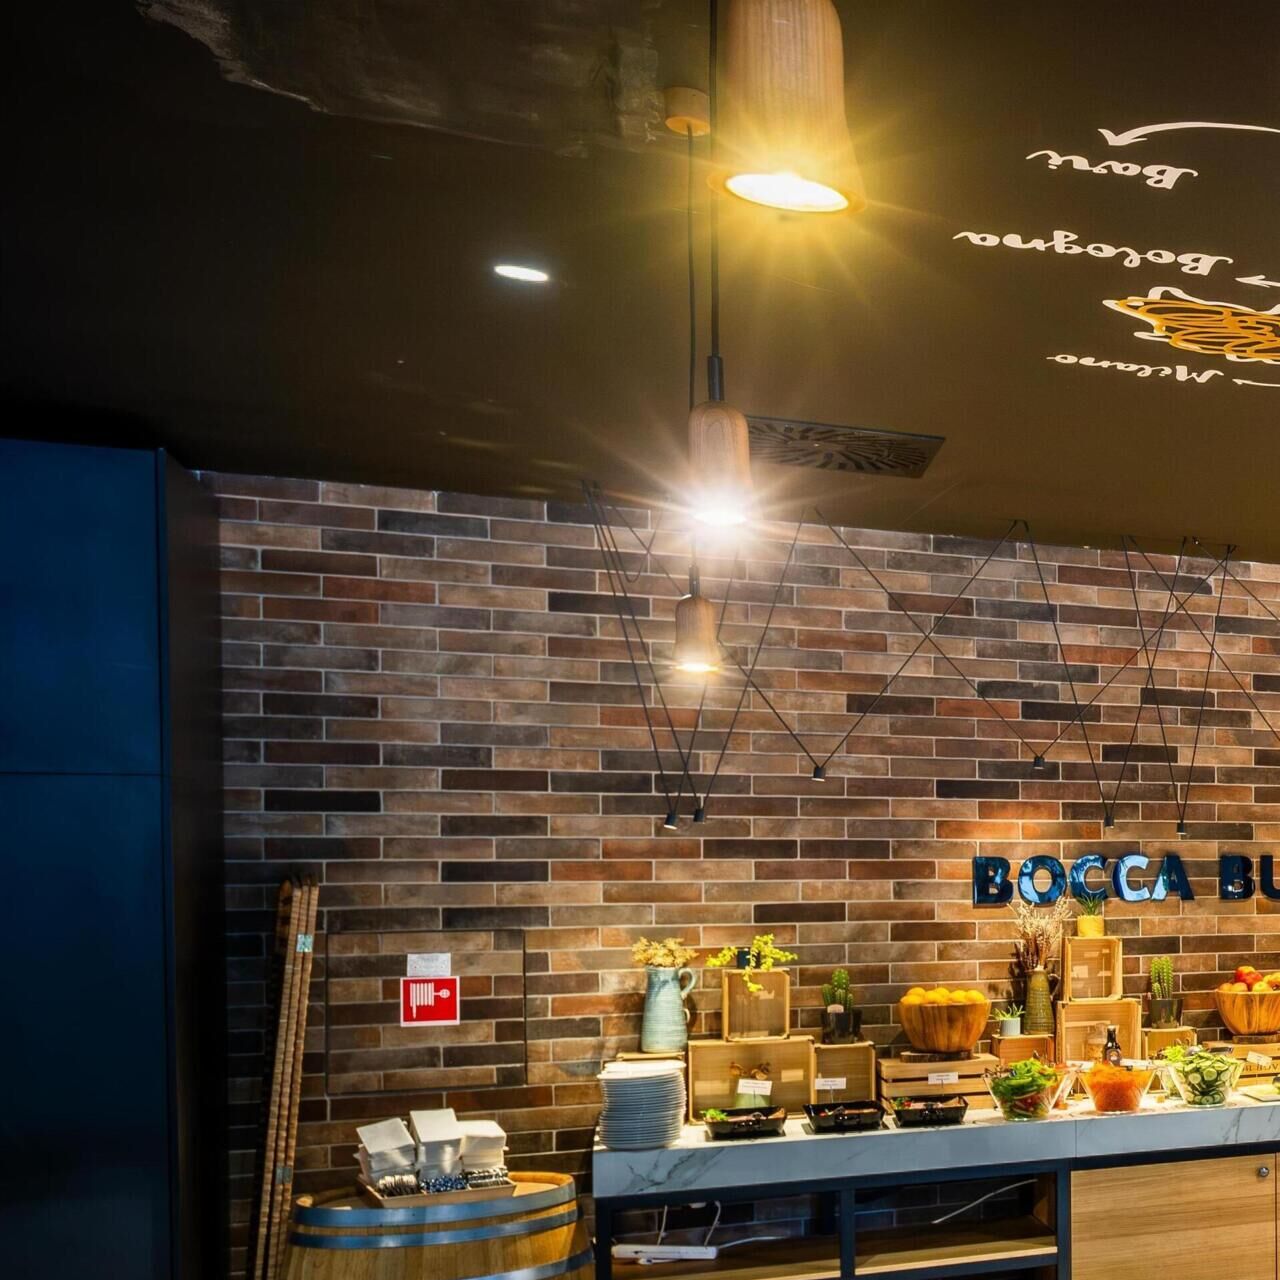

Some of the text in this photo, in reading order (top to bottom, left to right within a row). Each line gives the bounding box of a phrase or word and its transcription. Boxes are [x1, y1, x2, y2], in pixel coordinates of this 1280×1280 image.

[1025, 150, 1199, 190] Bari
[952, 230, 1234, 276] Bologna
[1045, 352, 1225, 384] Milano
[973, 855, 1195, 908] BOCCA
